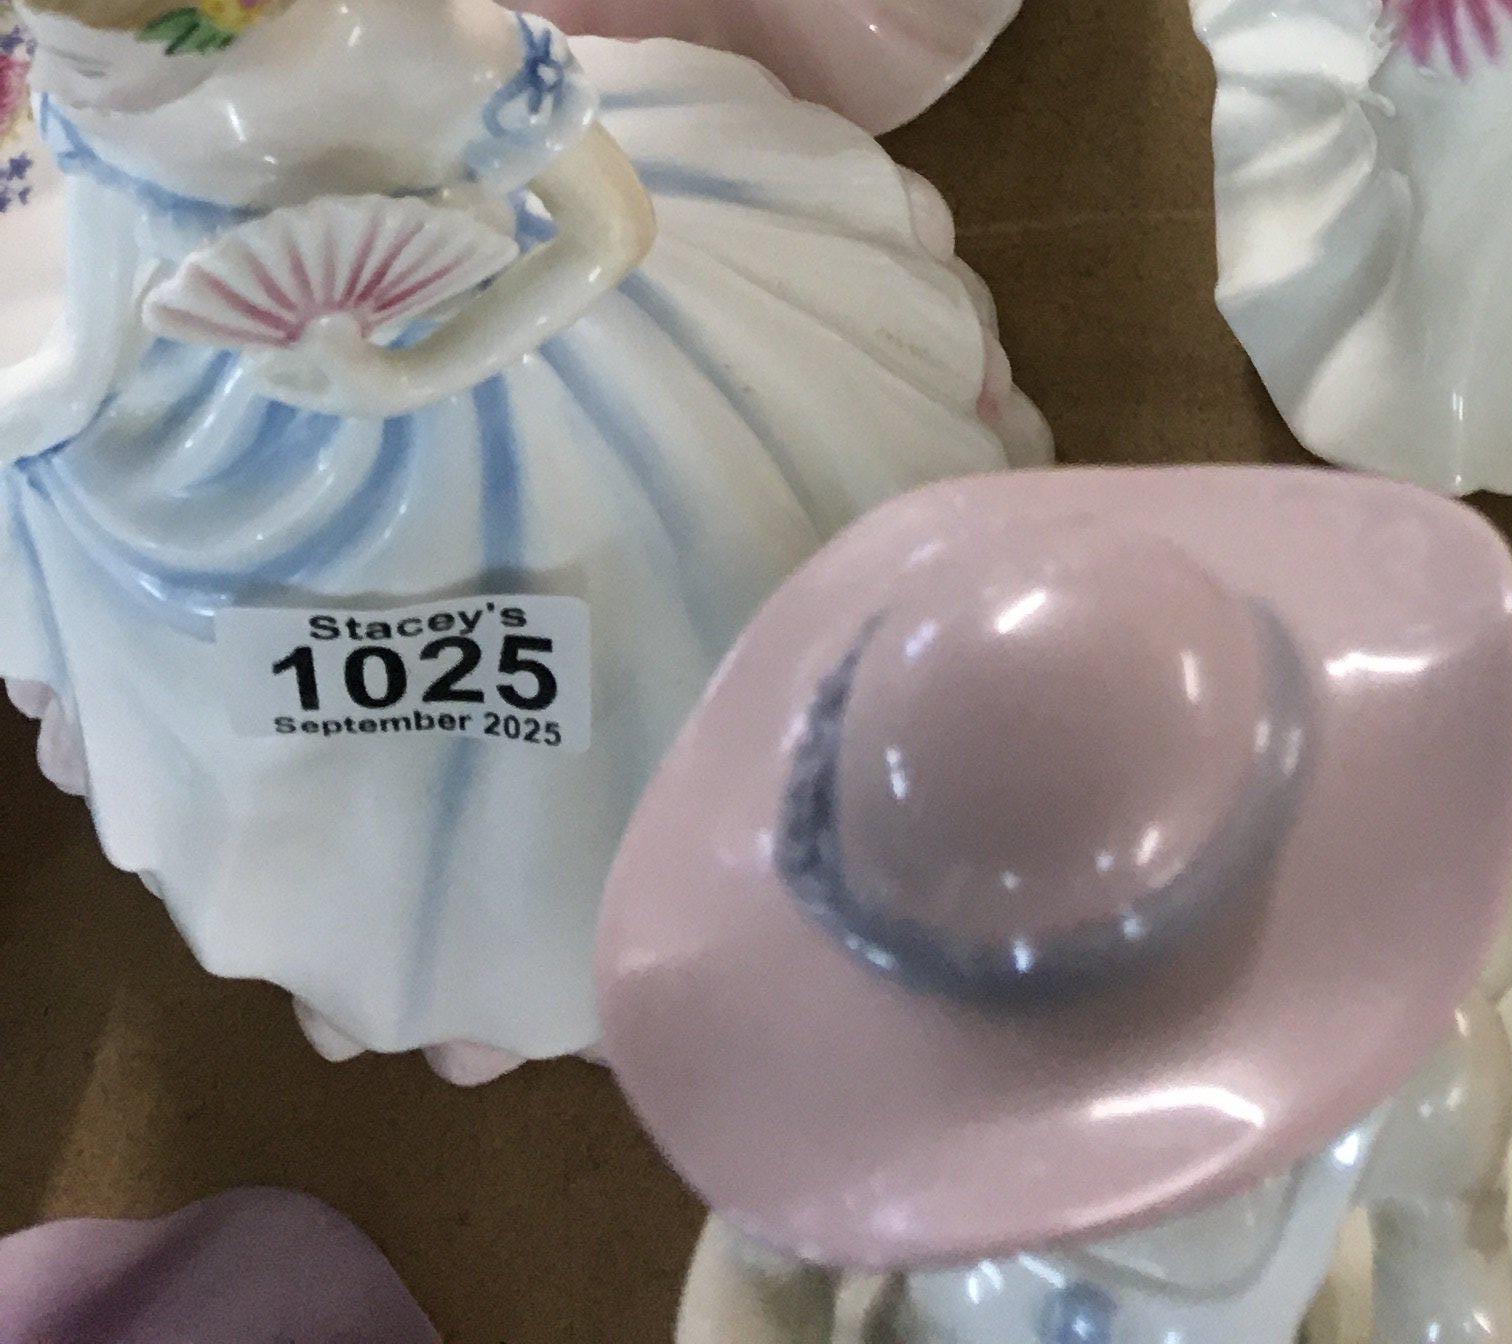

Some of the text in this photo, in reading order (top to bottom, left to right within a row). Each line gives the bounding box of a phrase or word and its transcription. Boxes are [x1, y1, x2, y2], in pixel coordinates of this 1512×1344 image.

[308, 601, 527, 641] Stacey's
[272, 634, 558, 712] 1025
[274, 710, 562, 748] September 2025
